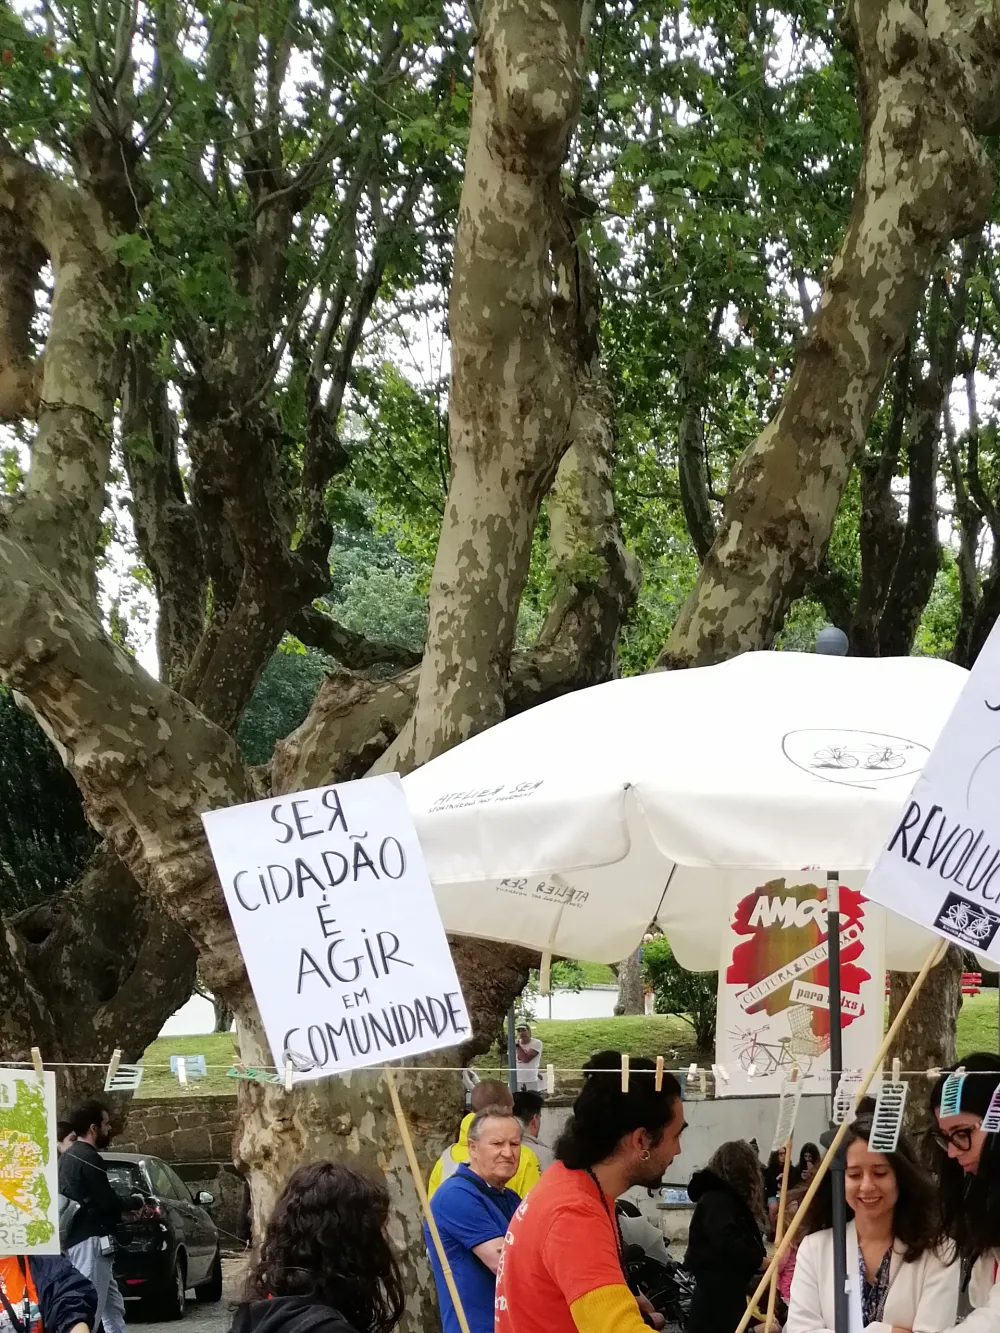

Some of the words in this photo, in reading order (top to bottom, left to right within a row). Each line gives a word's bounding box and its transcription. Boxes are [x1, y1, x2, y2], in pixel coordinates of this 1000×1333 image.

[232, 829, 407, 912] CIDADÃO
[296, 927, 414, 994] AGIR
[742, 966, 791, 1004] CULTURA
[342, 987, 371, 1009] EM
[795, 986, 823, 1003] para
[282, 991, 469, 1071] COMUNIDADE
